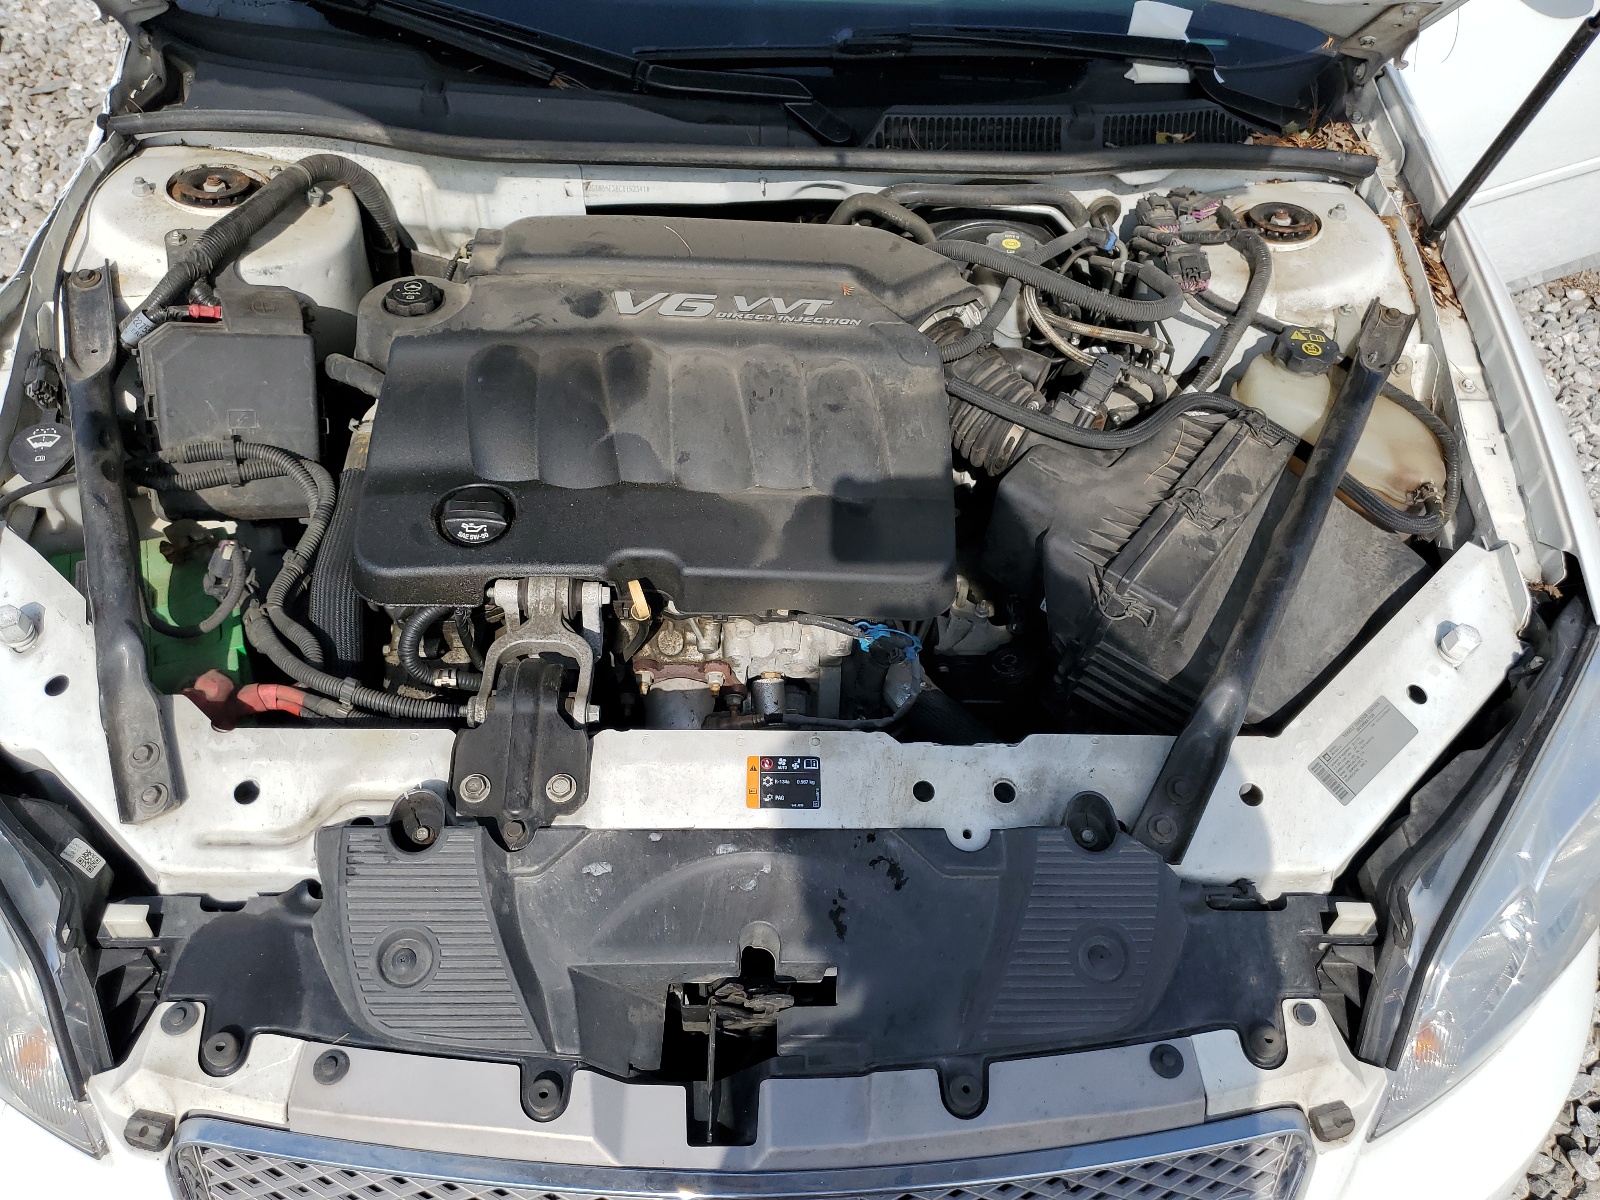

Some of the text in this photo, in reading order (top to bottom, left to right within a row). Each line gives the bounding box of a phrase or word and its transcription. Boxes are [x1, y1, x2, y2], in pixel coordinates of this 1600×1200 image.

[614, 291, 834, 318] V6 VVT
[715, 311, 863, 327] DIRECT INJECTION
[457, 531, 470, 540] SAE
